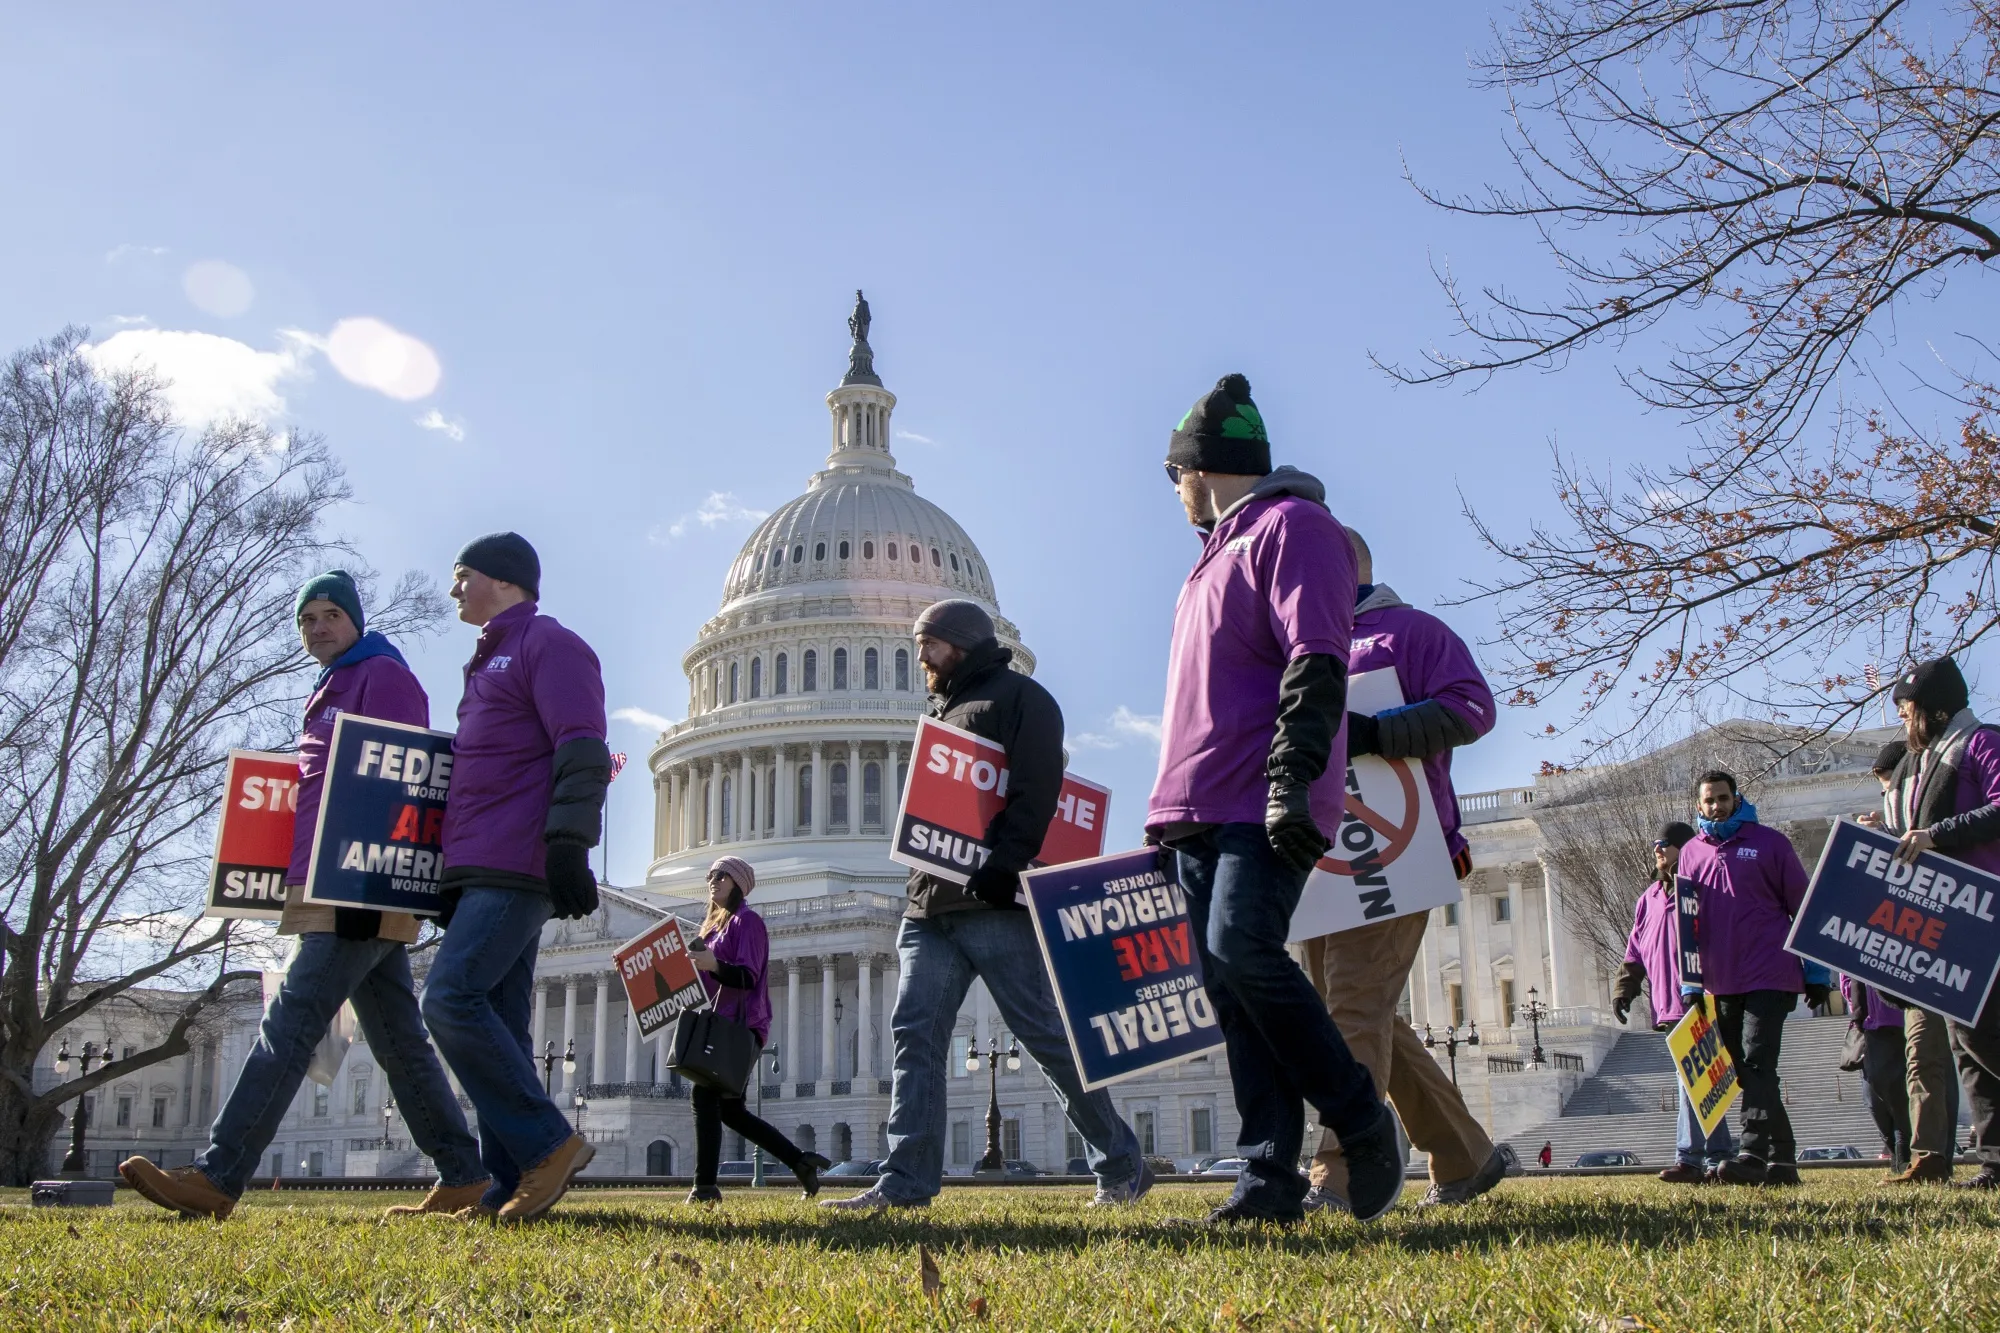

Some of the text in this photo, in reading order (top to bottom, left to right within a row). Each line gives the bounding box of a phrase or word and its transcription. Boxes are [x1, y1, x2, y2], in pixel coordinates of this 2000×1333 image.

[357, 740, 453, 789] FEDE
[408, 784, 449, 801] WORK
[908, 823, 992, 870] SHUT
[1737, 847, 1758, 857] ATC
[392, 877, 440, 895] WORKE
[1103, 870, 1166, 896] WORKERS
[1846, 840, 1995, 923] FEDERAL
[1888, 883, 1944, 914] WORKERS
[1867, 899, 1947, 951] ARE
[623, 930, 681, 979] STOP THE
[1112, 922, 1190, 982] ARE
[1819, 915, 1972, 992] AMERICAN
[1859, 953, 1917, 984] WORKERS
[640, 983, 702, 1030] SHUTDOWN
[1135, 974, 1198, 1002] WORKERS
[1089, 986, 1218, 1056] DERAL
[1690, 1015, 1711, 1045] REAL
[1707, 1055, 1728, 1088] REAL
